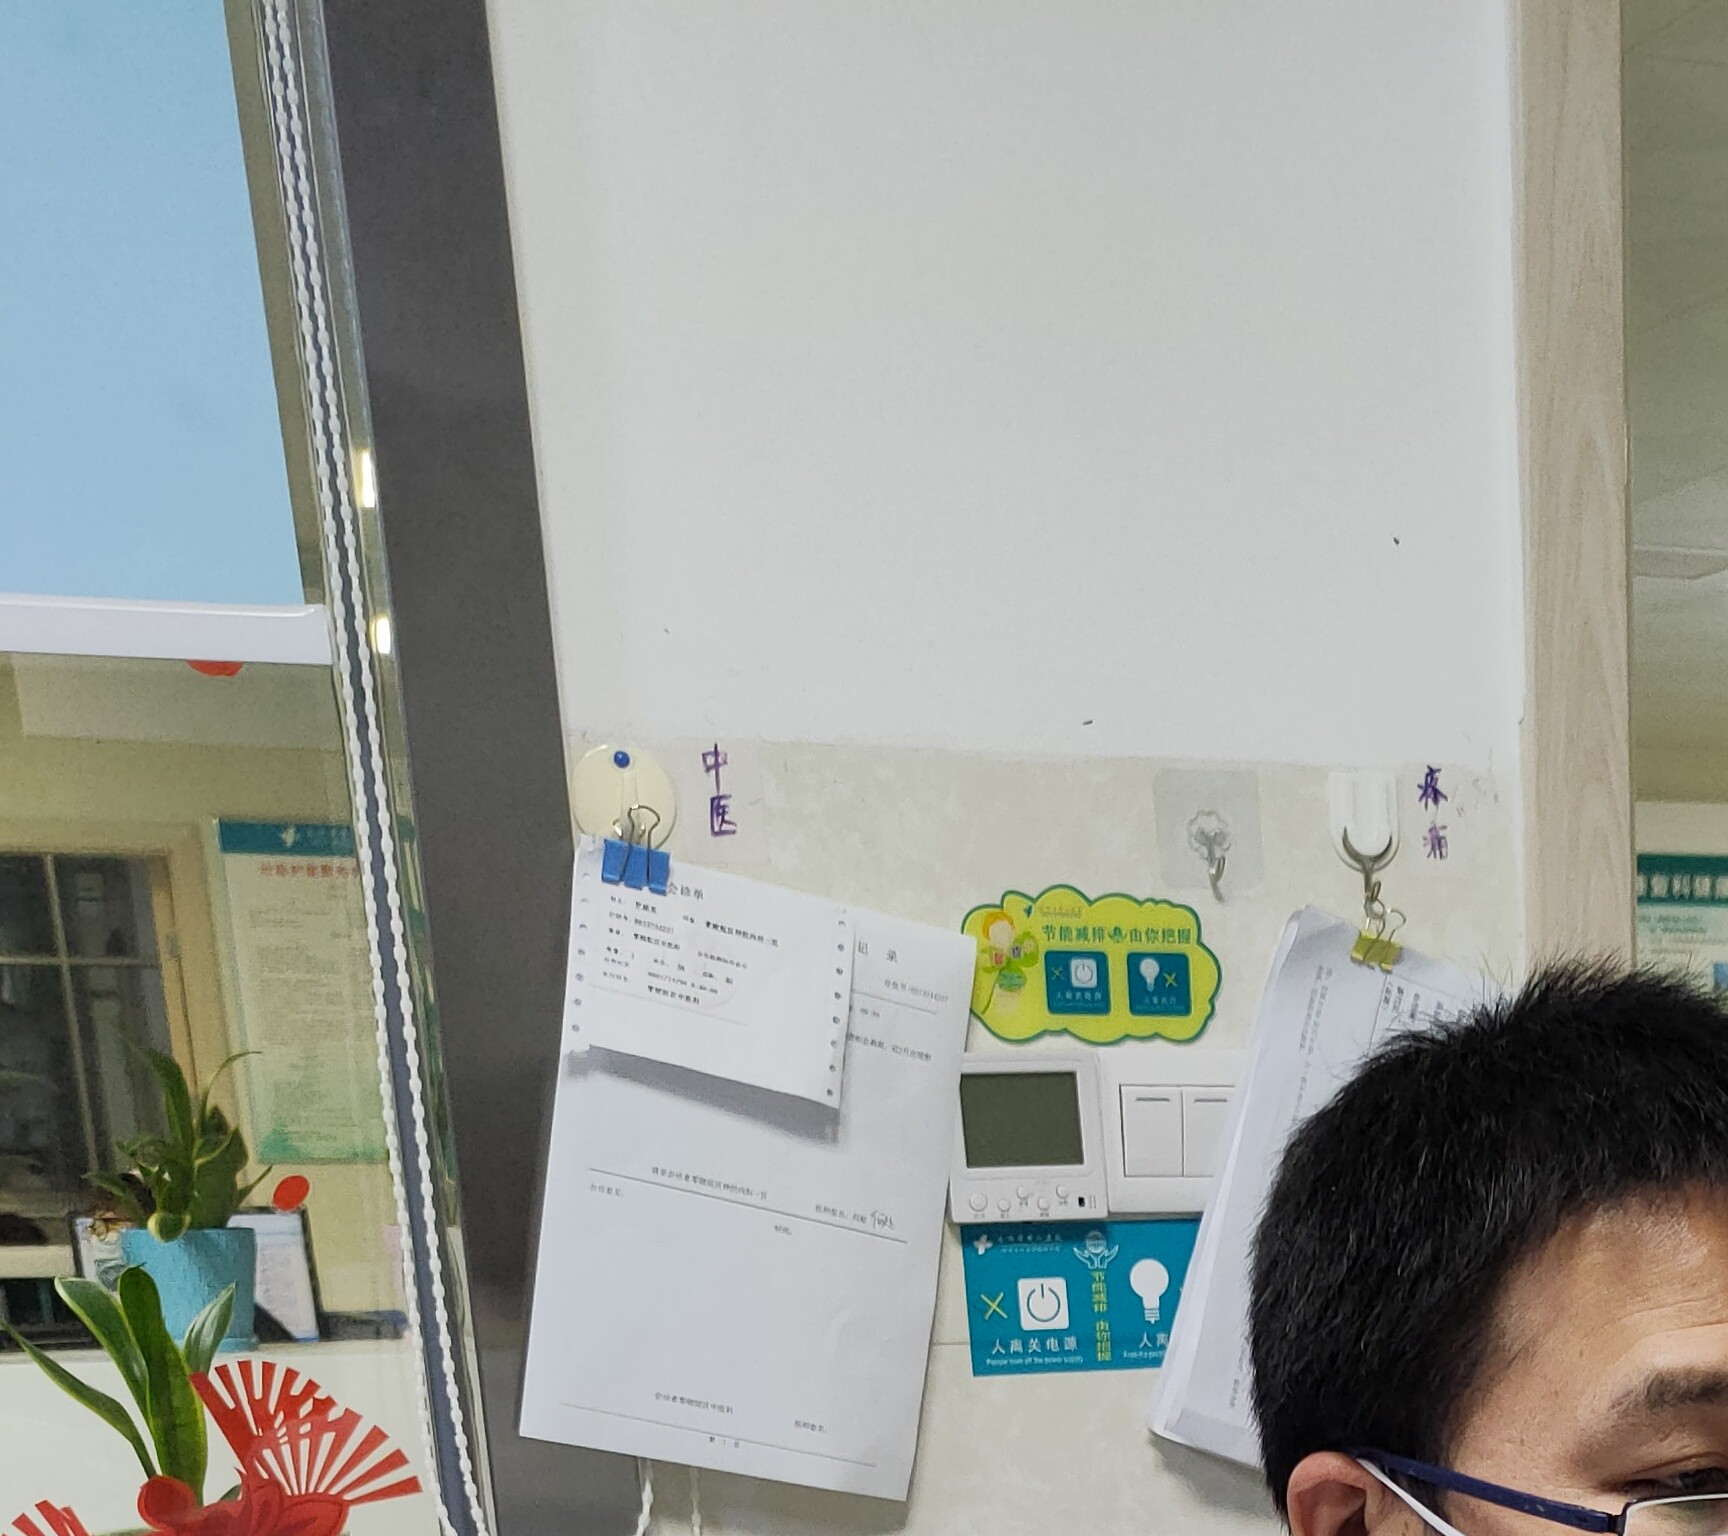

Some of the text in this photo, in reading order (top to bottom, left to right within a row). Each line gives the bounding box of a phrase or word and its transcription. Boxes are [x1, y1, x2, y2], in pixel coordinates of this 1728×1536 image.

[701, 743, 738, 837] 中医
[1042, 924, 1192, 945] 节能减排 由你把握
[991, 1336, 1078, 1355] 人离关电源
